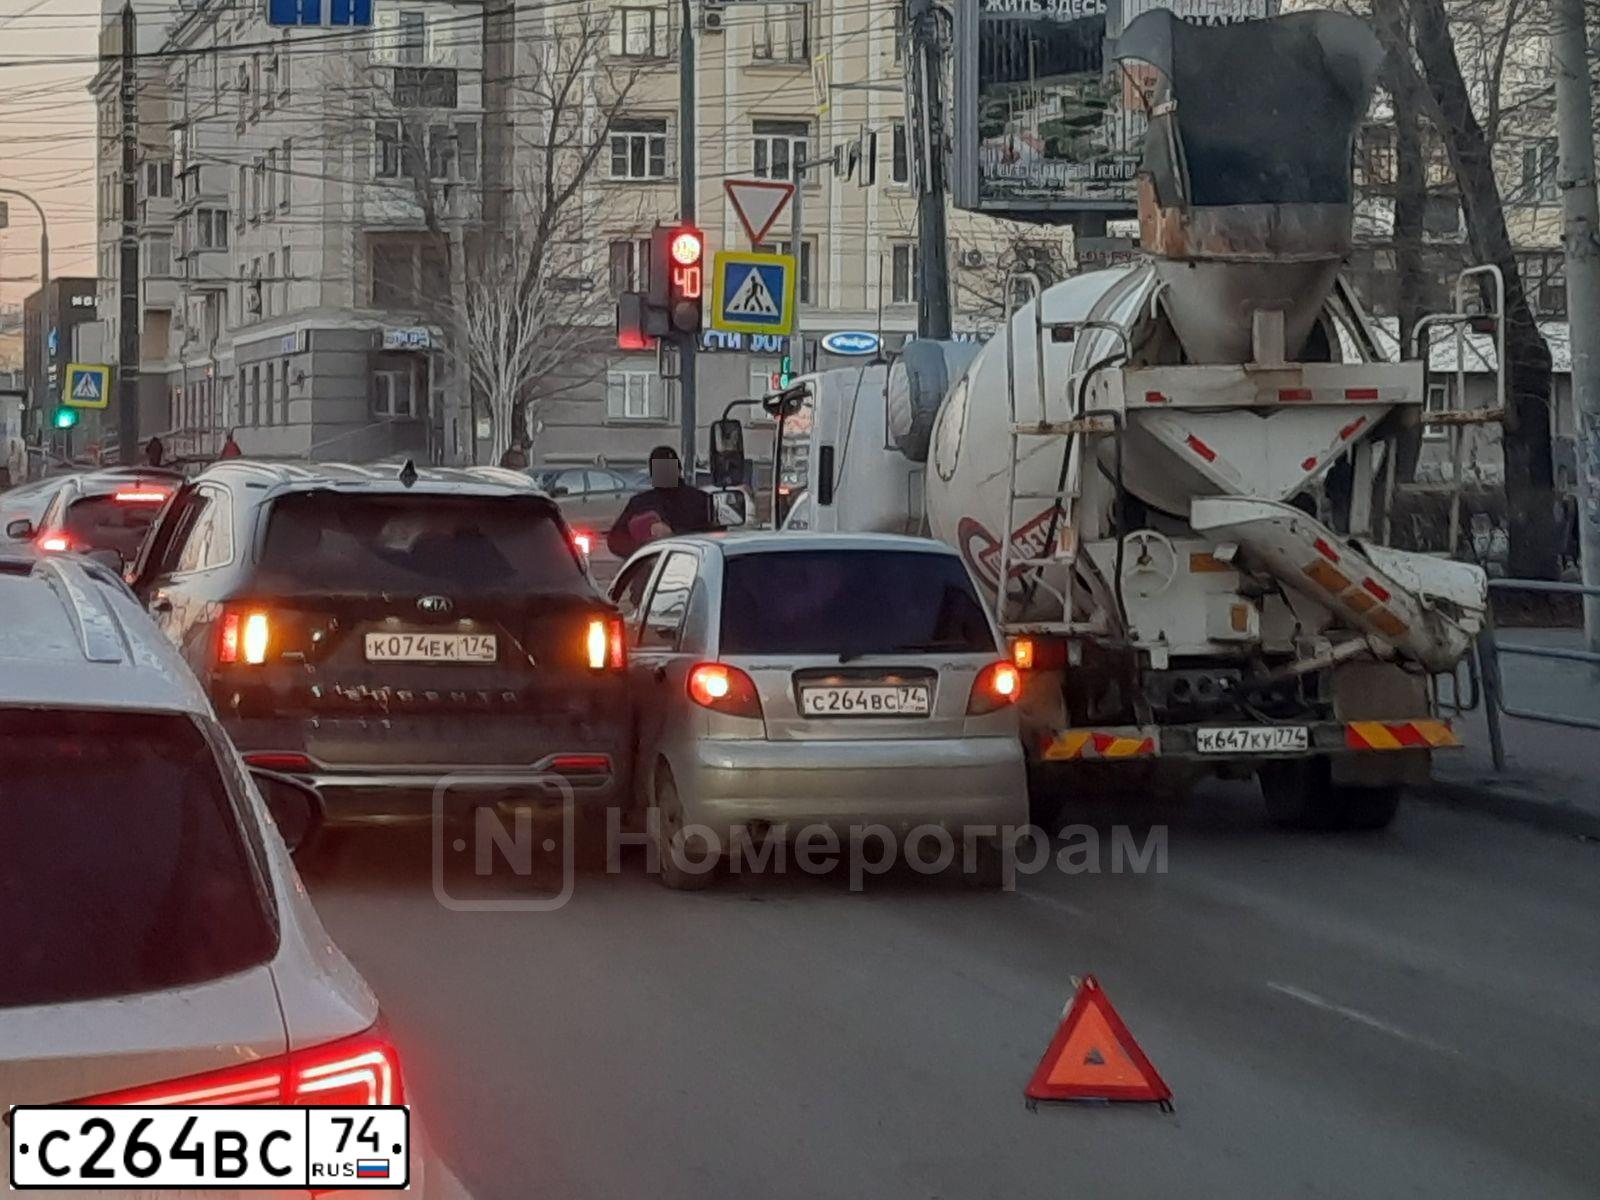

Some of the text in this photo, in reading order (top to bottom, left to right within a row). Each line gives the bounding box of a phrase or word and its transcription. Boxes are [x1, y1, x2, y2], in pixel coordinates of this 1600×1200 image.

[985, 0, 1107, 16] ЖИТЬ ЗДЕСЬ
[674, 267, 700, 297] 40
[374, 637, 494, 657] К074ЕК 174
[812, 691, 896, 711] С264ВС
